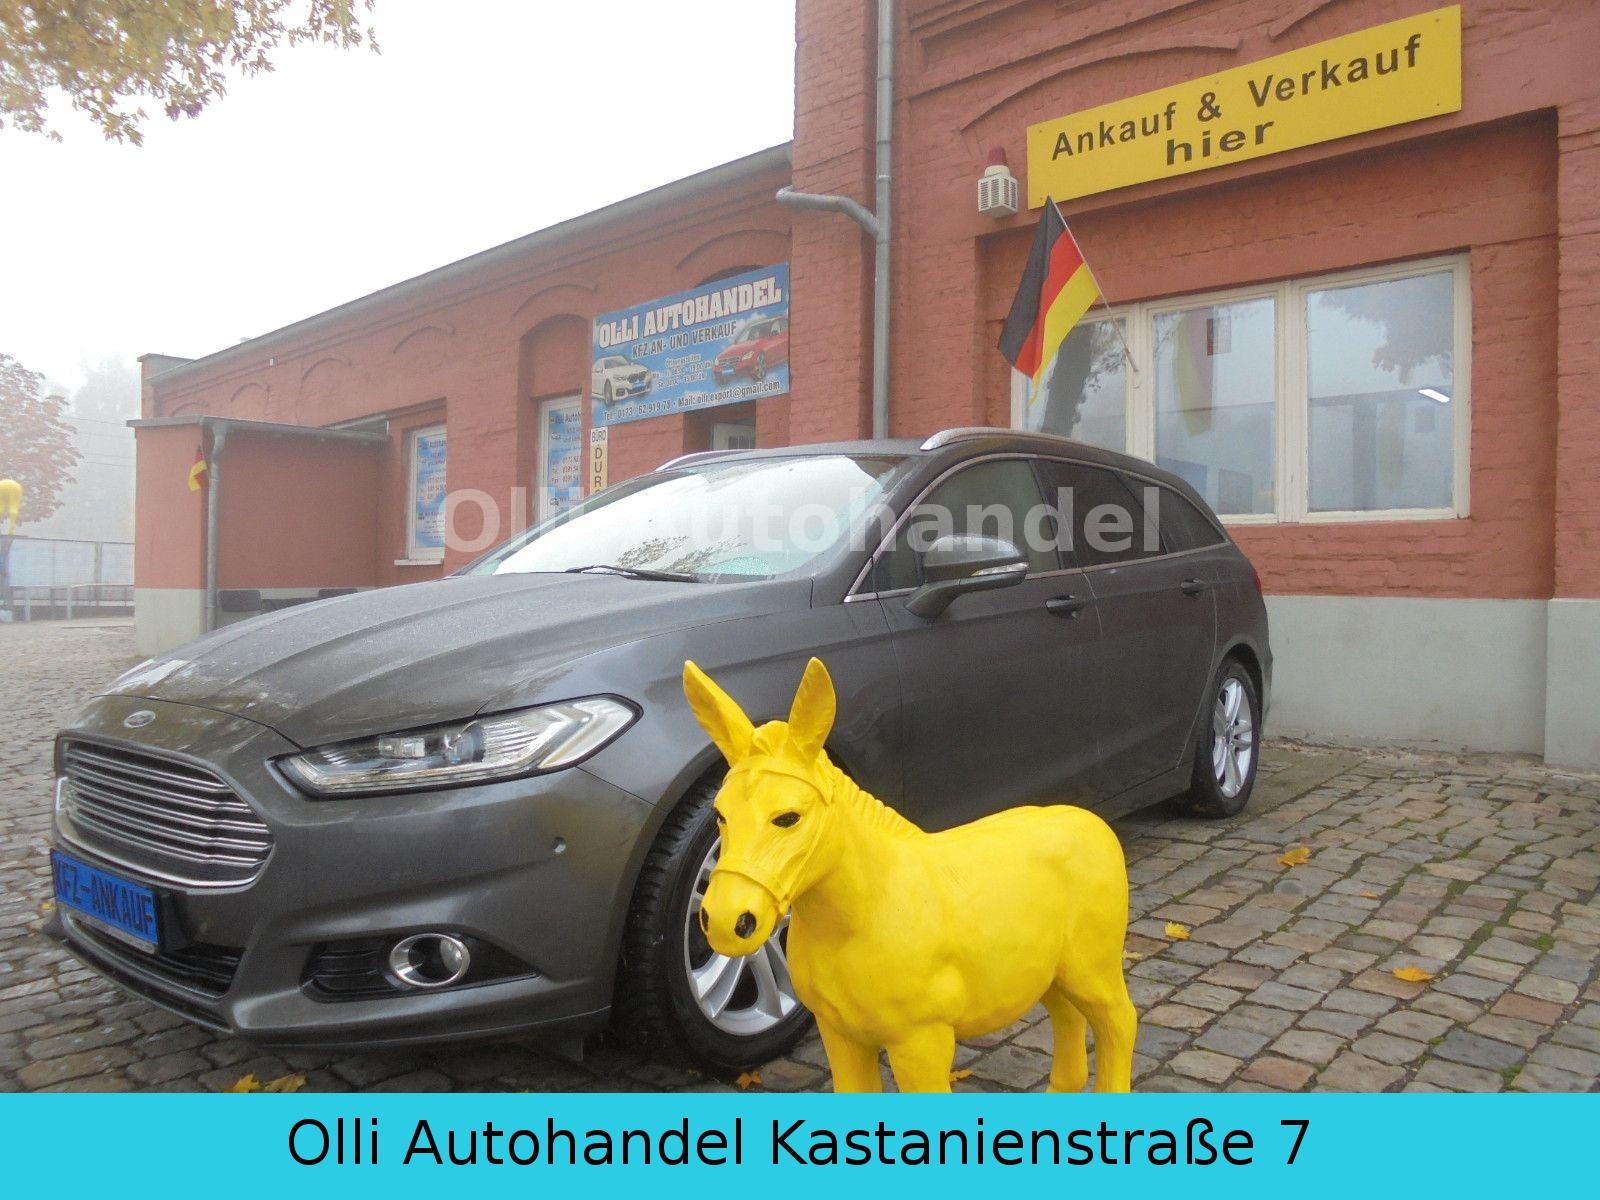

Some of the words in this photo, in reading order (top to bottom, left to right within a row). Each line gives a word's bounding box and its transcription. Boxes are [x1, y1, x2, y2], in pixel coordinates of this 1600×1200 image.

[1051, 101, 1177, 162] Ankauf
[1197, 91, 1223, 123] &
[1247, 34, 1422, 108] Verkauf
[1166, 118, 1275, 166] hier
[600, 315, 640, 349] OLLI
[643, 276, 782, 337] AUTOHANDEL
[632, 343, 648, 358] KFZ
[650, 339, 667, 355] AN-
[670, 333, 689, 350] UND
[692, 321, 737, 345] VERKAUF
[594, 447, 603, 493] DUR
[54, 857, 153, 935] KFZ-ANKAUF
